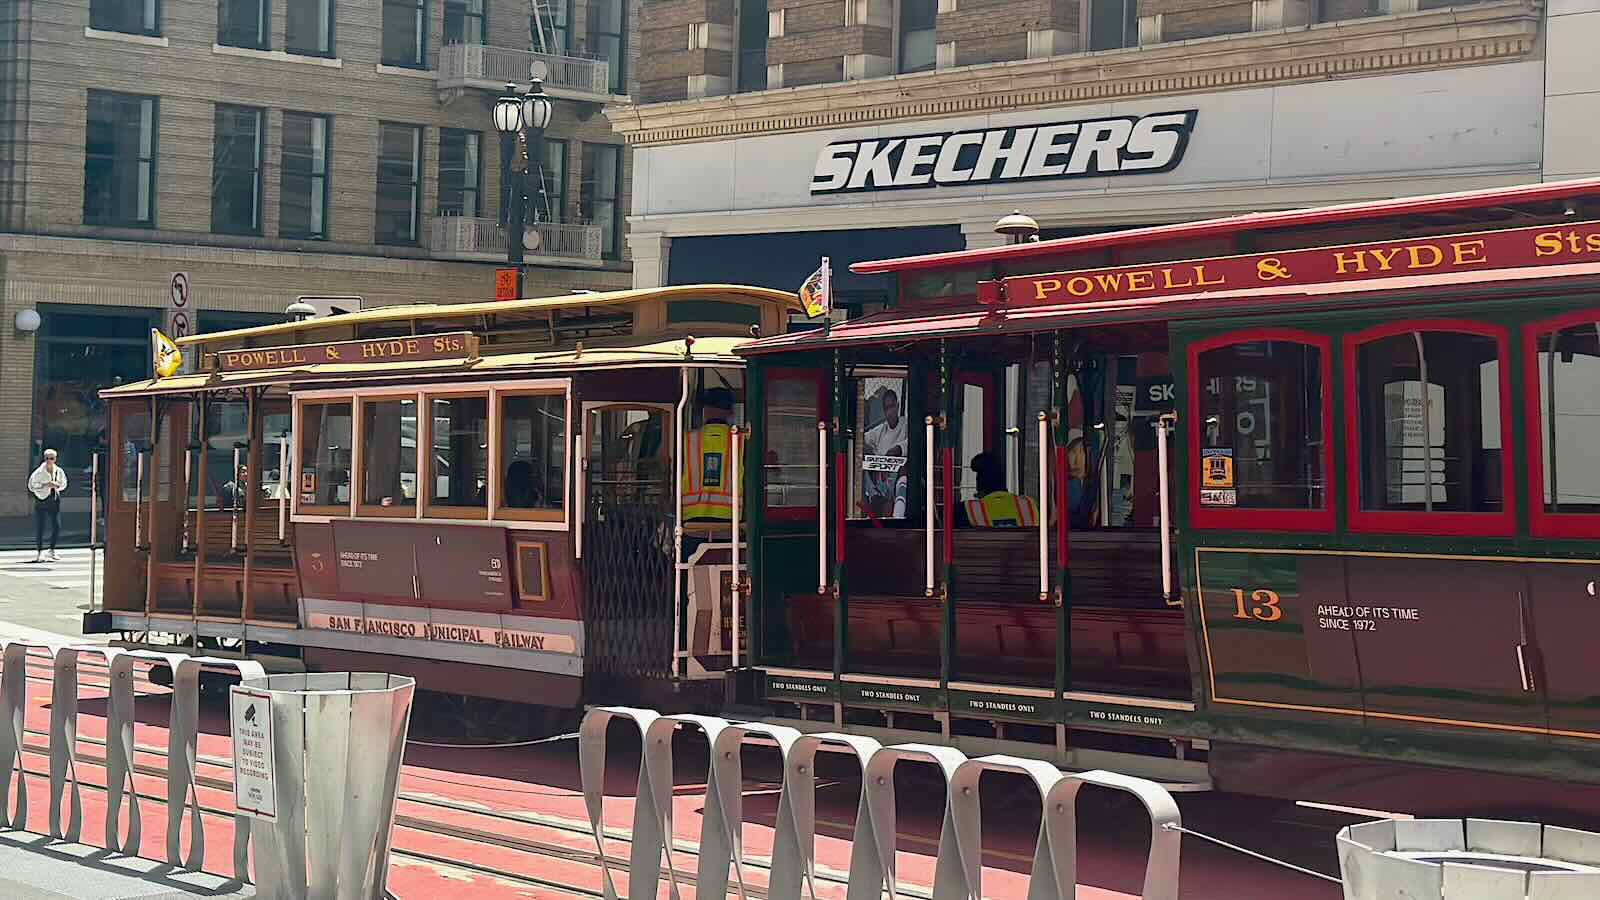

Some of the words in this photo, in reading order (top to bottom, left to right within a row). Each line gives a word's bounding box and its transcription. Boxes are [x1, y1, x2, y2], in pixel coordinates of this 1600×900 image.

[811, 113, 1188, 191] SKECHERS
[1033, 265, 1226, 299] POWELL
[1257, 258, 1291, 281] &
[1335, 240, 1487, 274] HYDE
[1535, 230, 1600, 256] Sts
[227, 350, 306, 367] POWELL
[326, 345, 341, 360] &
[362, 340, 420, 357] HYDE
[433, 335, 464, 353] Sts.
[1230, 587, 1282, 622] 13
[1317, 605, 1353, 617] AHEAD
[1356, 606, 1371, 618] OF
[1373, 607, 1390, 619] ITS
[1393, 608, 1420, 620] TIME
[329, 616, 351, 629] SAN
[1319, 618, 1350, 630] SINCE
[1353, 619, 1377, 631] 1972
[772, 682, 785, 690] TWO
[786, 683, 811, 692] STANDEES
[812, 685, 827, 693] ONLY
[861, 690, 874, 698] TWO
[876, 691, 903, 700] STANDEES
[905, 694, 920, 702] ONLY
[969, 700, 984, 708] TWO
[986, 702, 1016, 711] STANDEES
[1018, 704, 1035, 713] ONLY
[1089, 710, 1106, 719] TWO
[1108, 712, 1142, 723] STANDEES
[1144, 716, 1164, 725] ONLY
[254, 740, 262, 748] BE
[242, 748, 264, 758] SUBJECT
[243, 757, 249, 766] TO
[250, 759, 264, 768] VIDEO
[240, 767, 268, 780] RECORDING
